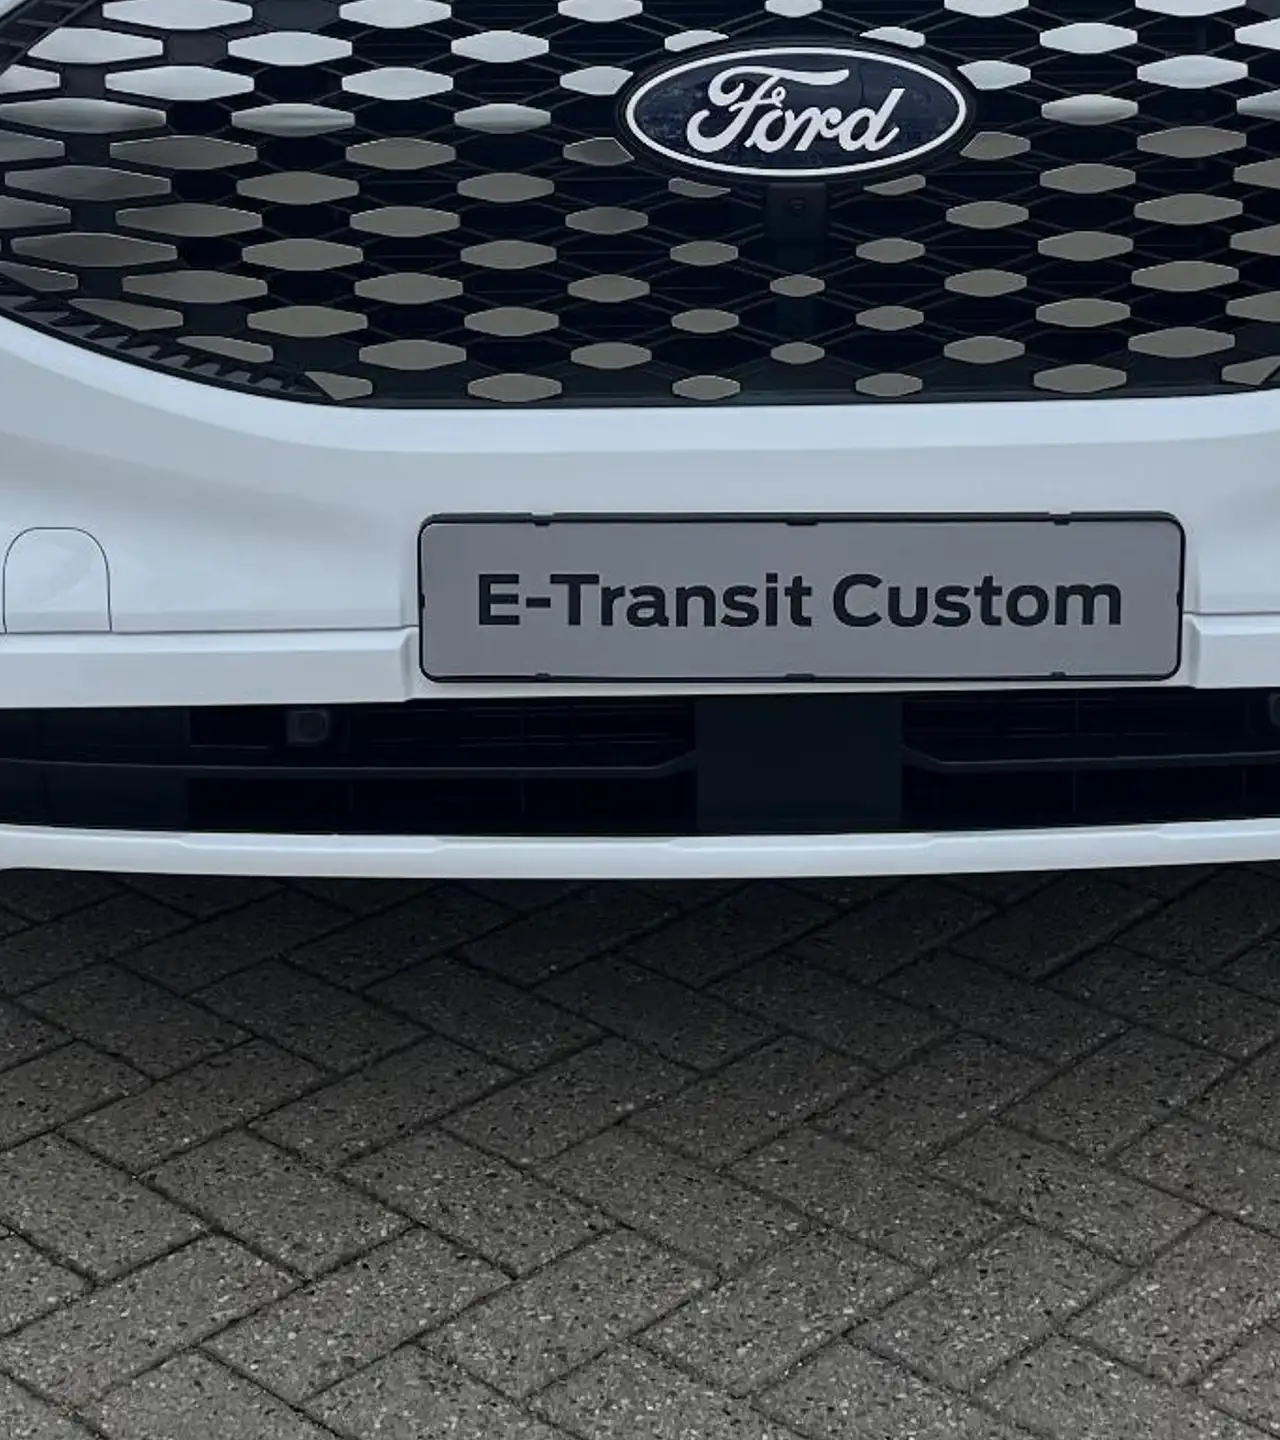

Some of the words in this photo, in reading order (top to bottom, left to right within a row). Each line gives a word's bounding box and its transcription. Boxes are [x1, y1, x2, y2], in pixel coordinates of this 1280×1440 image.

[686, 65, 906, 153] Ford
[477, 572, 813, 628] E-Transit
[831, 572, 1123, 628] Custom
